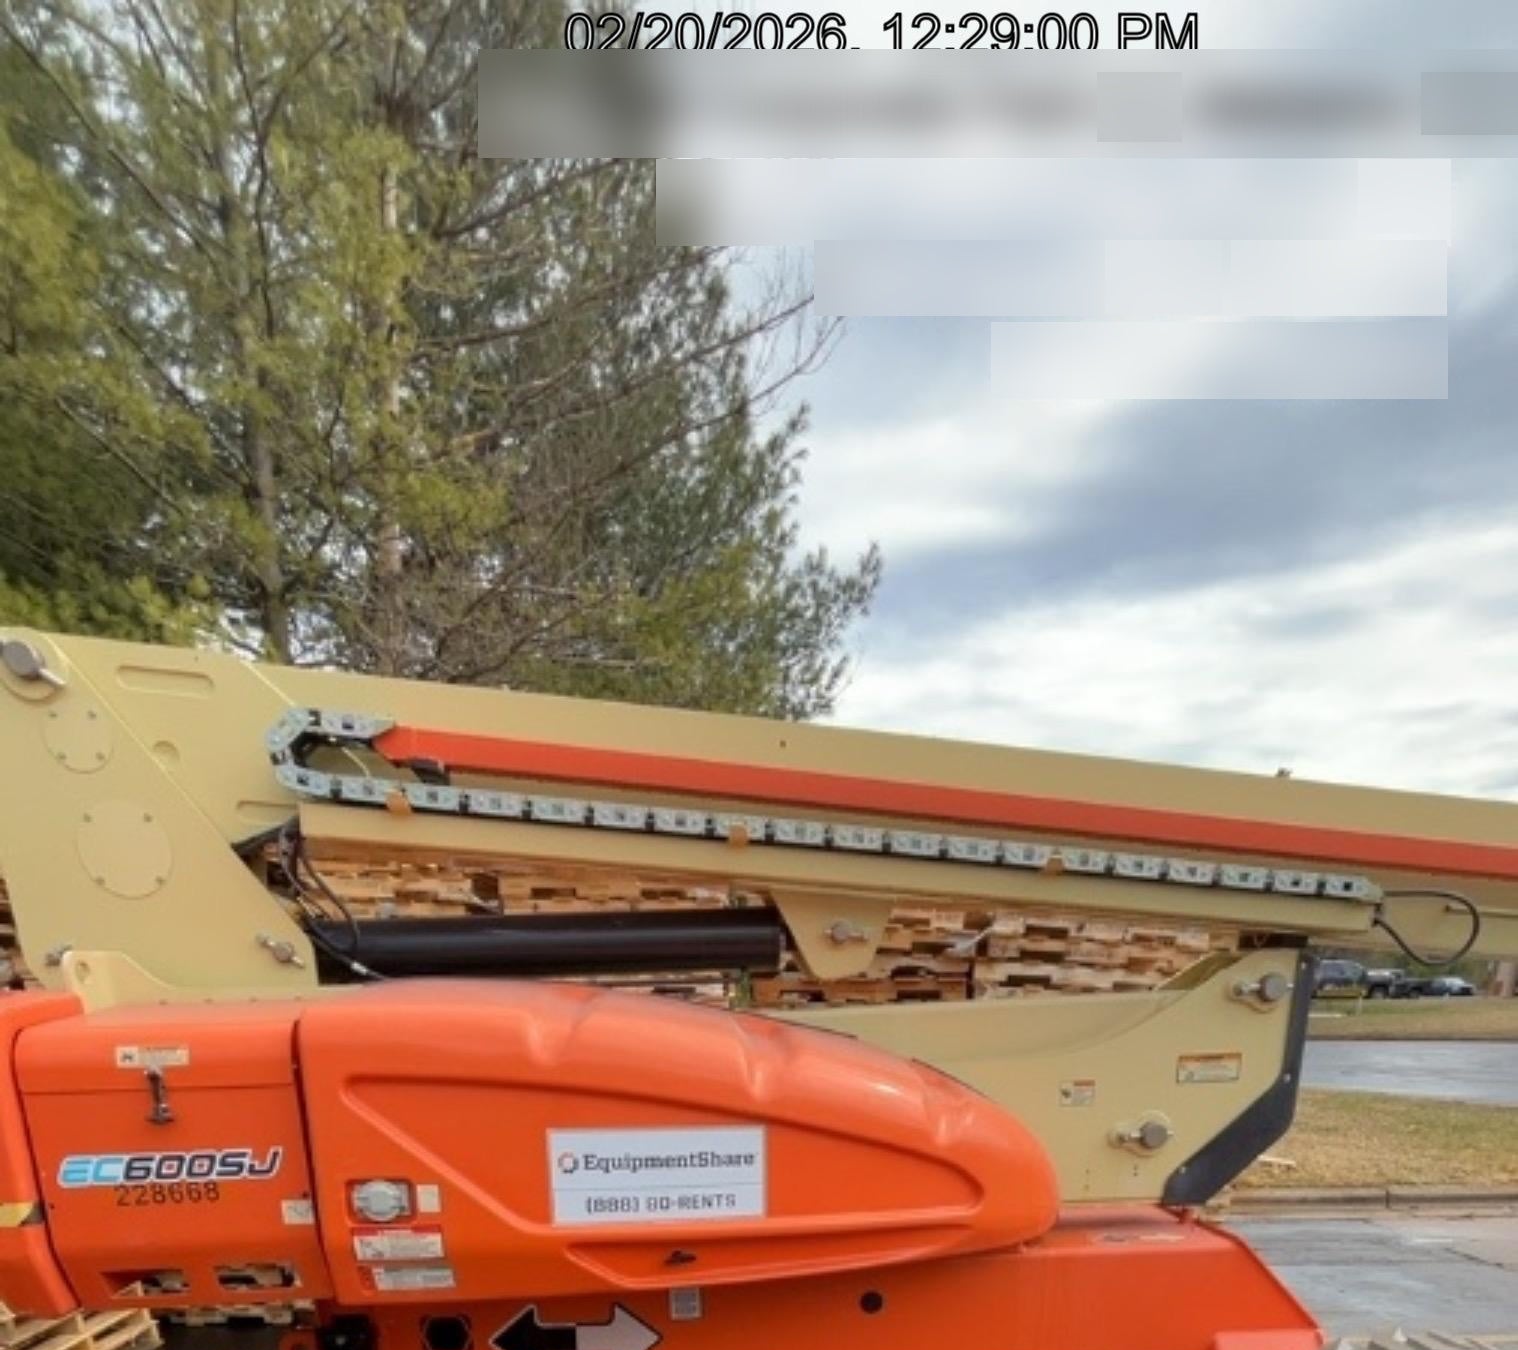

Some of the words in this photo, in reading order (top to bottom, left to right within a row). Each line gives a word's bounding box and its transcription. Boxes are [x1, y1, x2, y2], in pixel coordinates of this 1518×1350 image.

[59, 1148, 281, 1185] EC600SJ
[583, 1152, 755, 1174] EquipmentShare
[114, 1181, 221, 1207] 228668
[586, 1196, 640, 1213] (888)
